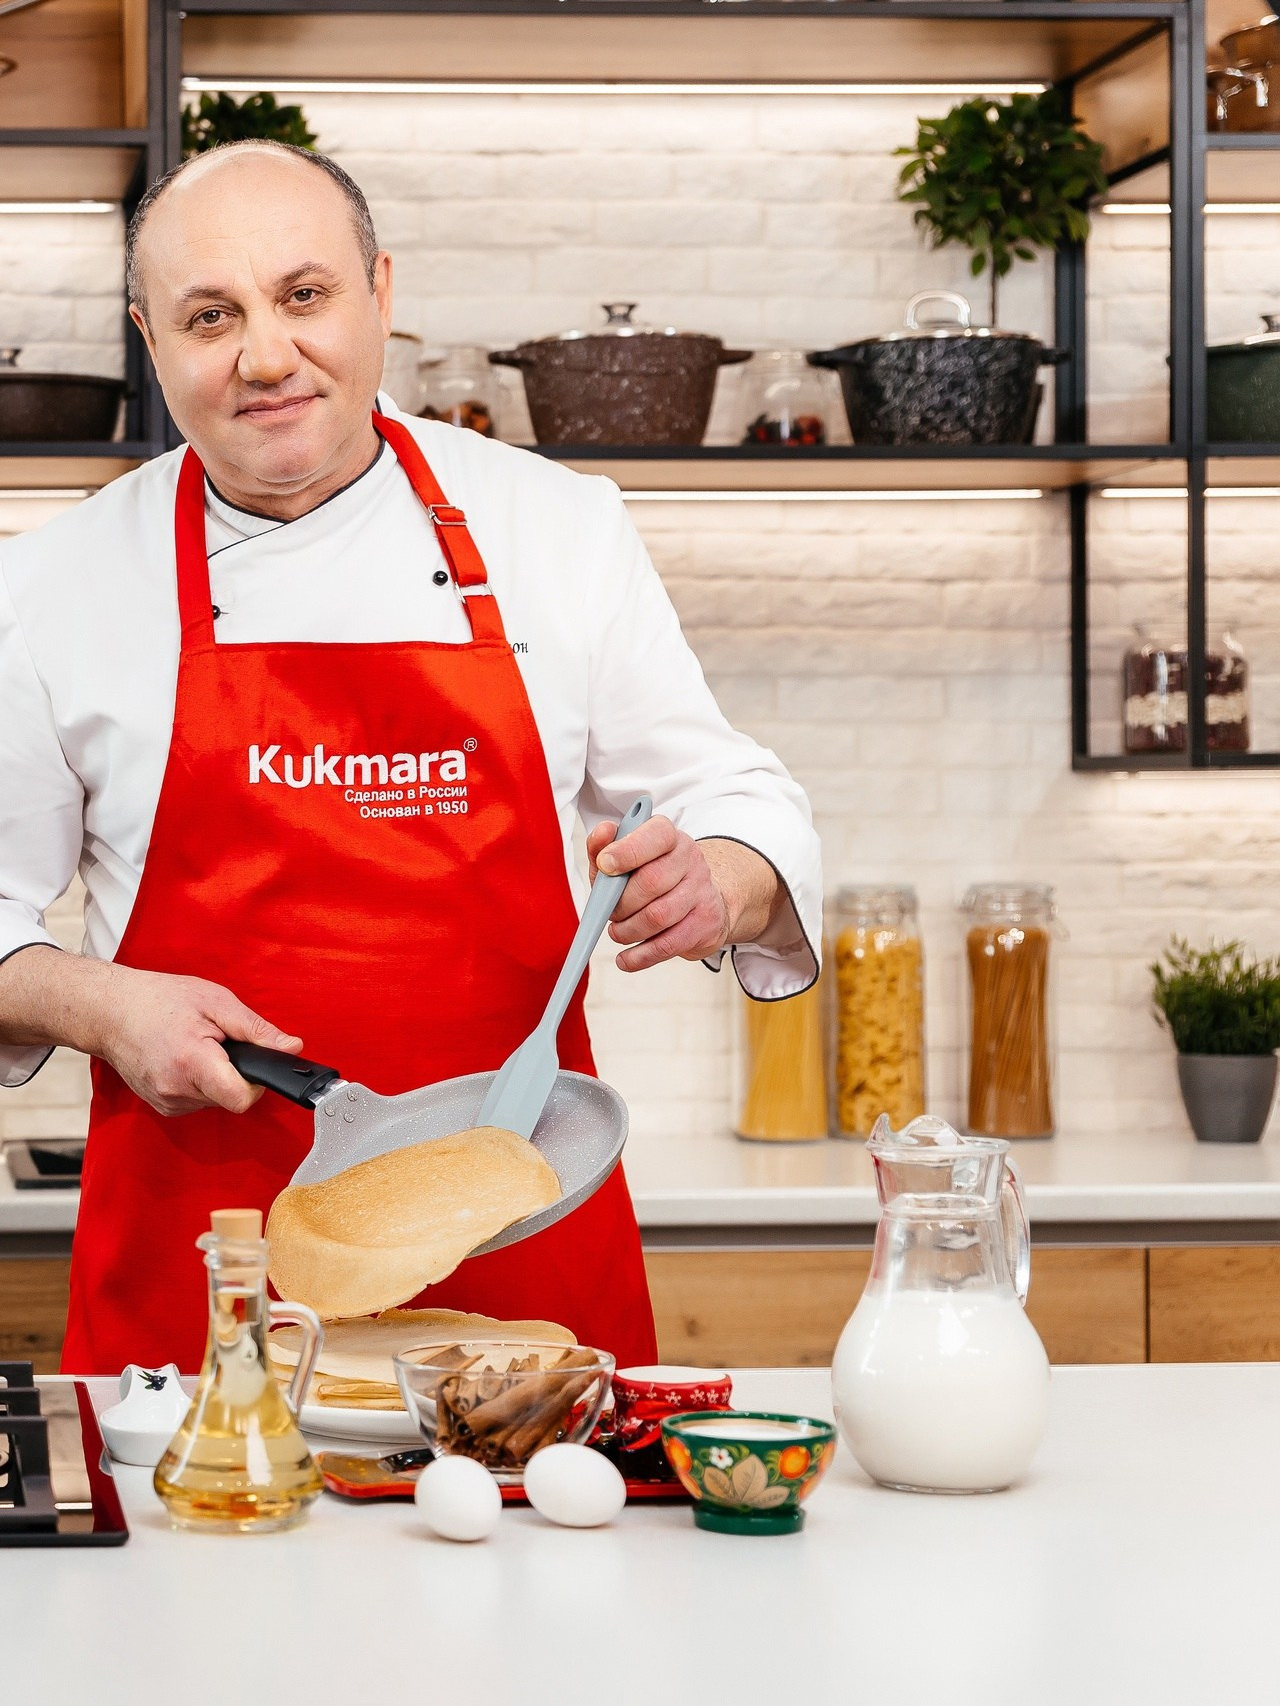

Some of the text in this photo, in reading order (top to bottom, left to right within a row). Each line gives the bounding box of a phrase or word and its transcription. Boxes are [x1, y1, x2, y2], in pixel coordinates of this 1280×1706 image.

[344, 785, 468, 804] Сделано в России
[359, 800, 469, 819] Основан в 1950
